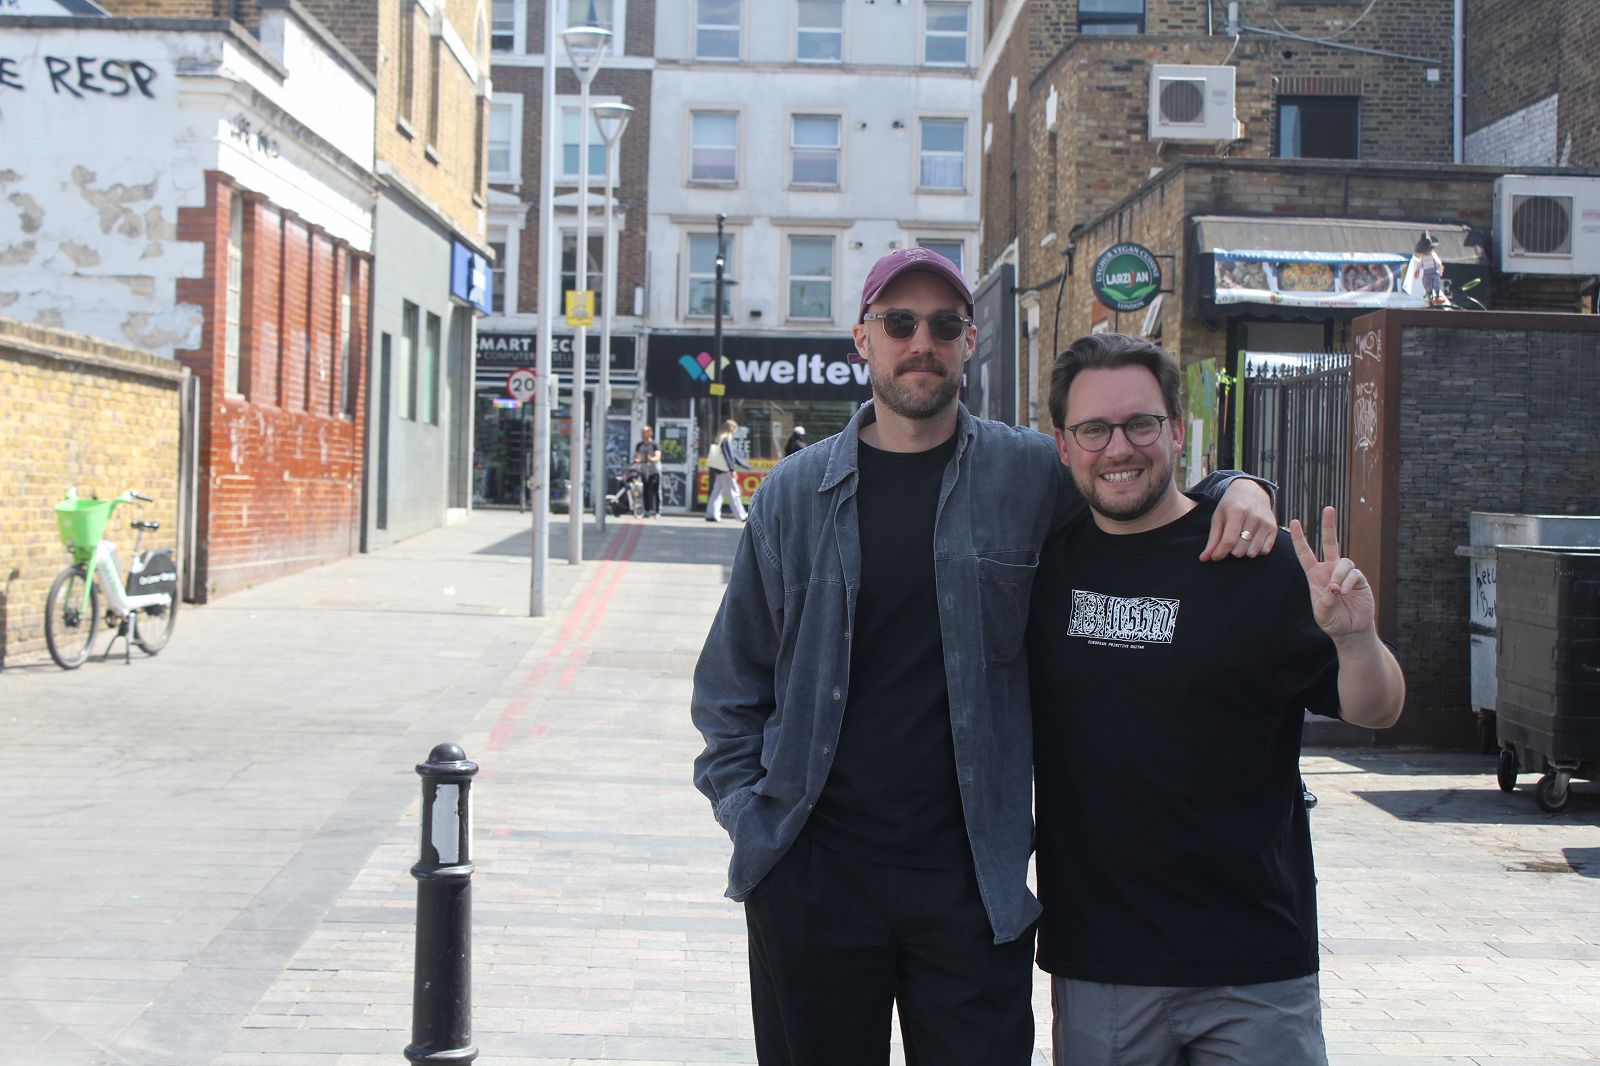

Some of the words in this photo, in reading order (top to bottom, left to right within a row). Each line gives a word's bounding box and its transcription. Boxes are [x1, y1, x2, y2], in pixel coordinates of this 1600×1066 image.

[45, 56, 157, 98] RESP
[1112, 245, 1140, 255] VEGAN
[476, 338, 532, 352] MART
[551, 339, 576, 352] EC
[512, 378, 536, 392] 20
